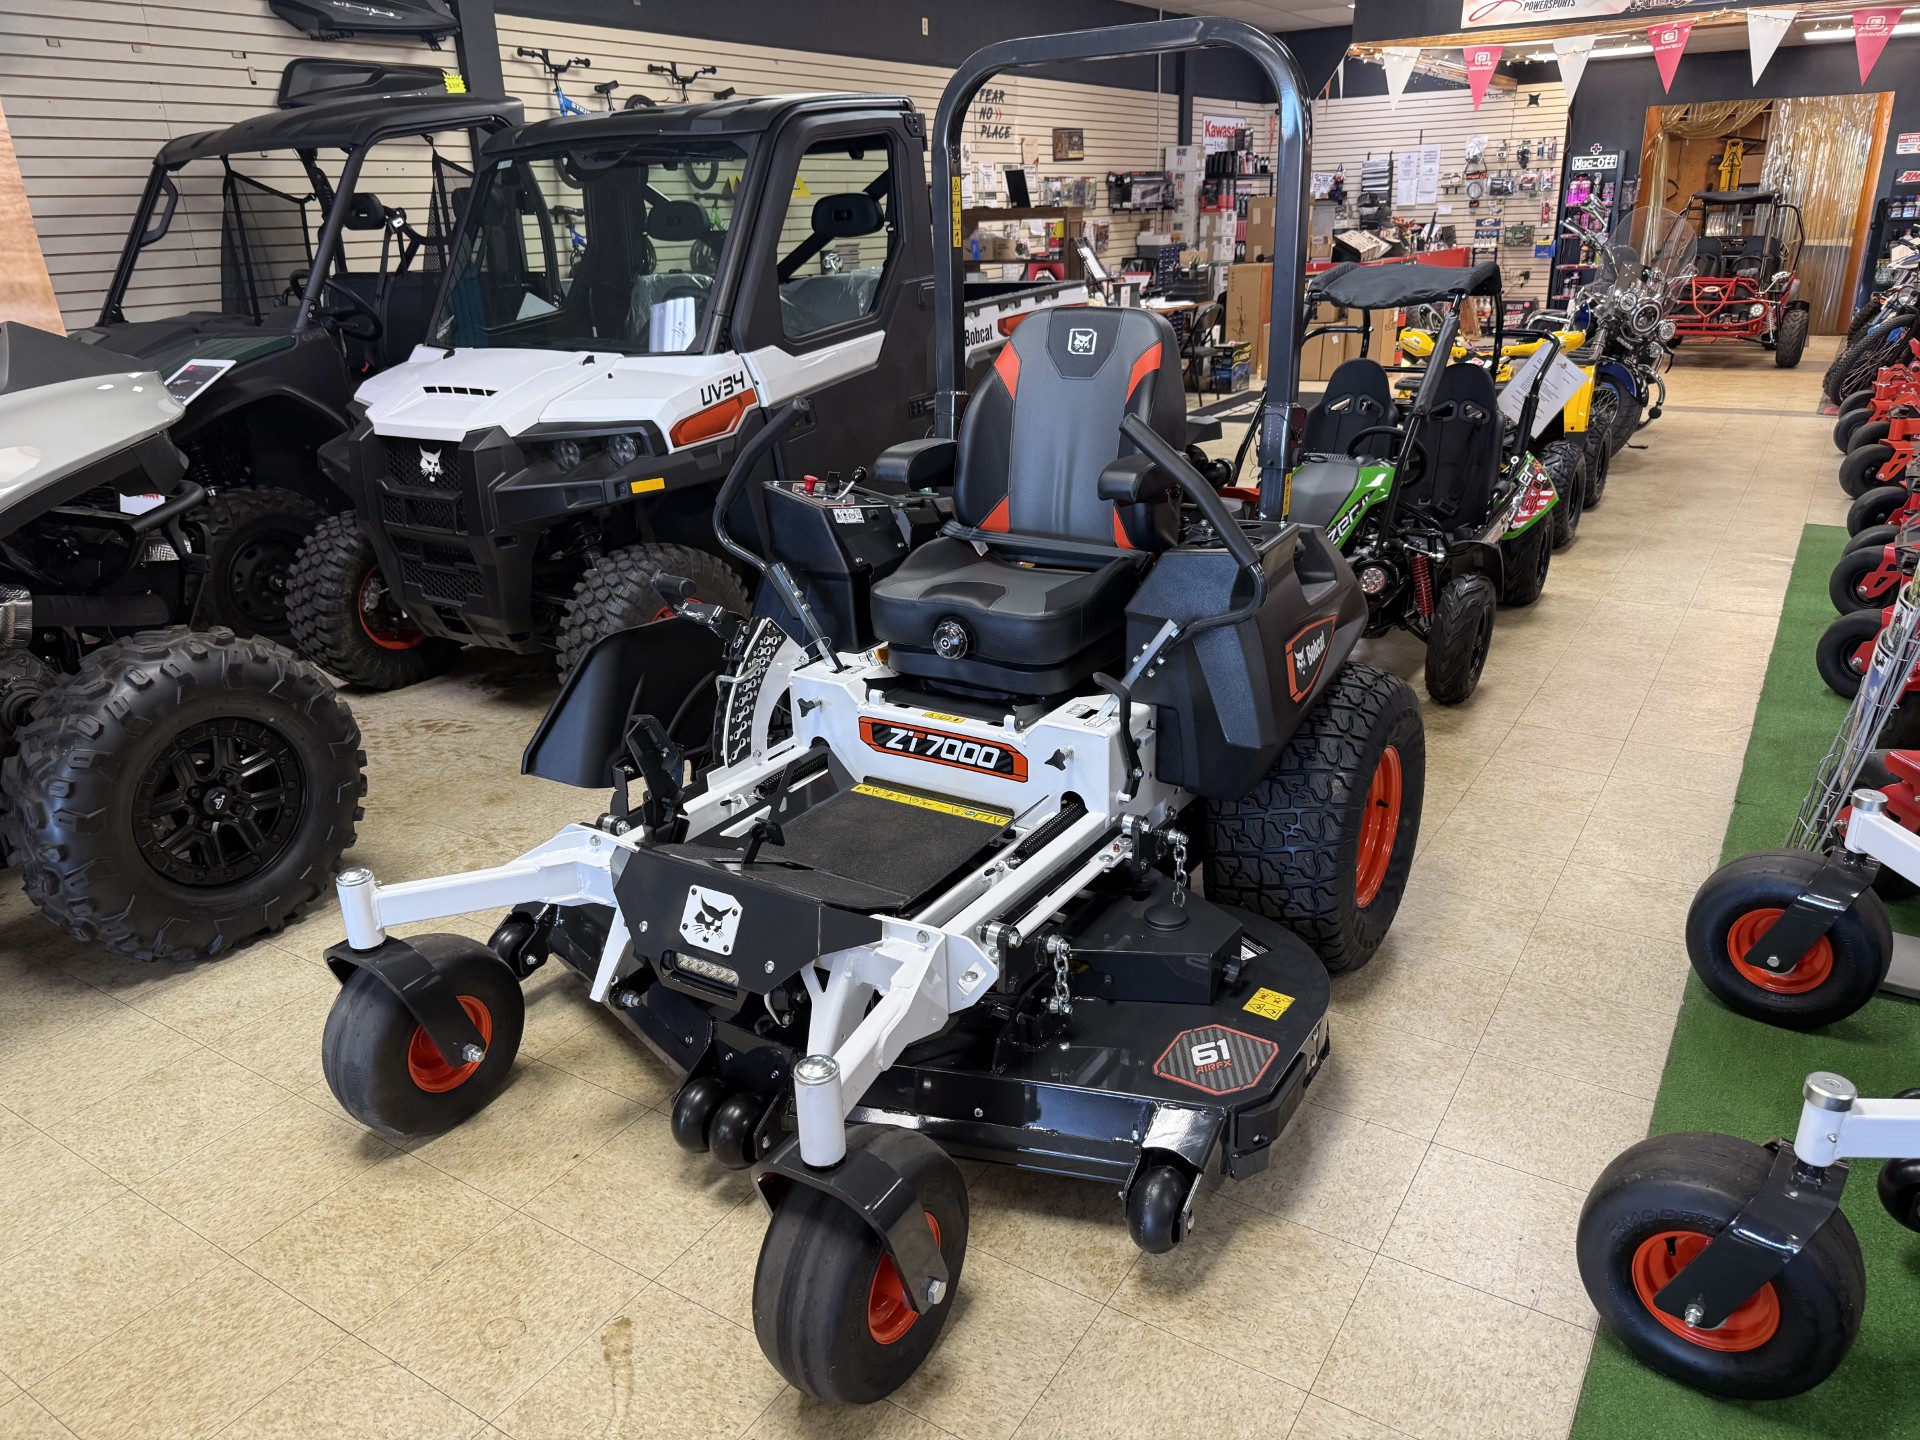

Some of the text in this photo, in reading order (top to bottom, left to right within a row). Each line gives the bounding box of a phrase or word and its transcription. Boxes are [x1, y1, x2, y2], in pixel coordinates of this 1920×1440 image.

[1655, 43, 1683, 51] GRAVELY
[979, 88, 1005, 104] FEAR
[979, 105, 993, 120] NO
[1205, 120, 1243, 138] Kawasa
[1574, 157, 1615, 169] Muc-Off
[965, 323, 993, 347] Bobcat
[700, 370, 745, 406] UV34
[1305, 630, 1326, 667] Bobcat
[1191, 1039, 1231, 1067] 61
[1609, 1207, 1724, 1241] SMOOTH
